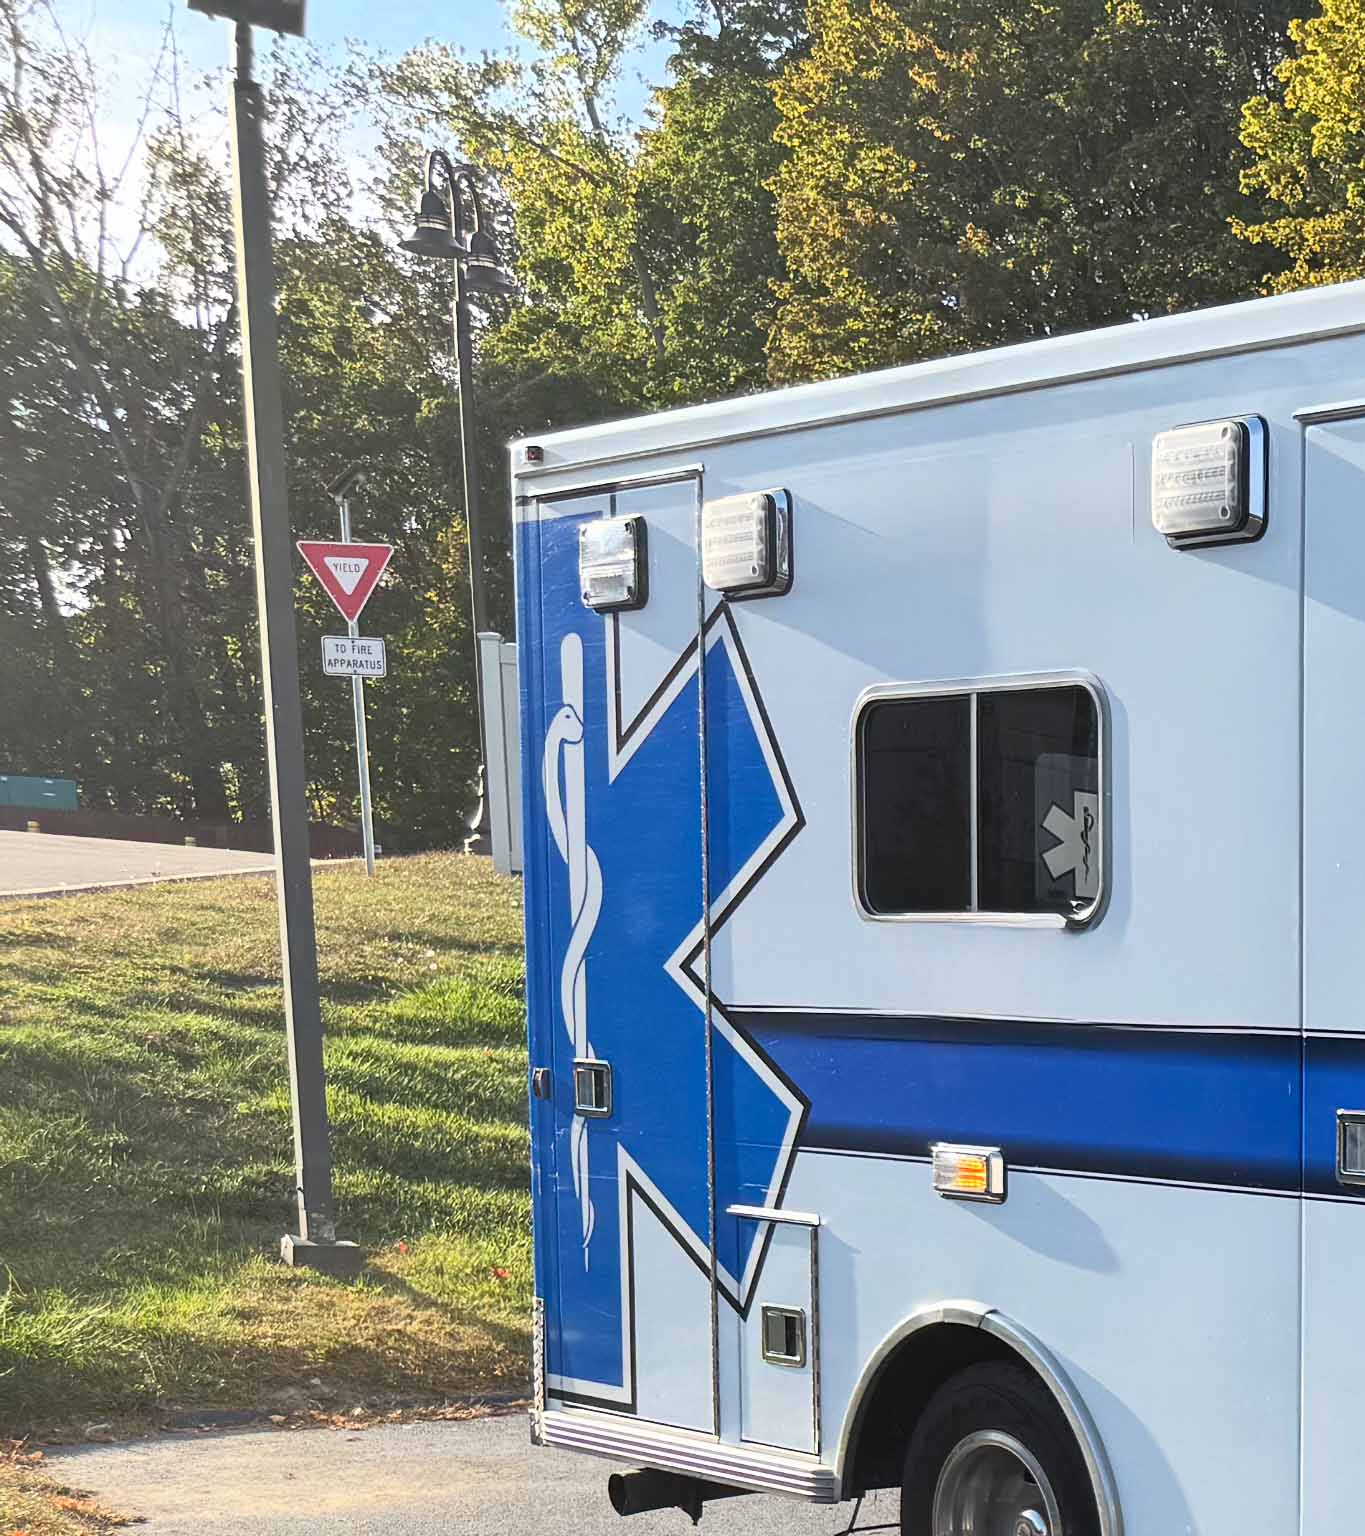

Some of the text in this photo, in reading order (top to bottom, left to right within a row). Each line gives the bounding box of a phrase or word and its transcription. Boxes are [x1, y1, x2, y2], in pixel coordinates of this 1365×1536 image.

[332, 562, 360, 573] YIELD
[335, 643, 373, 655] TO FIRE
[327, 658, 382, 670] APPARATUS
